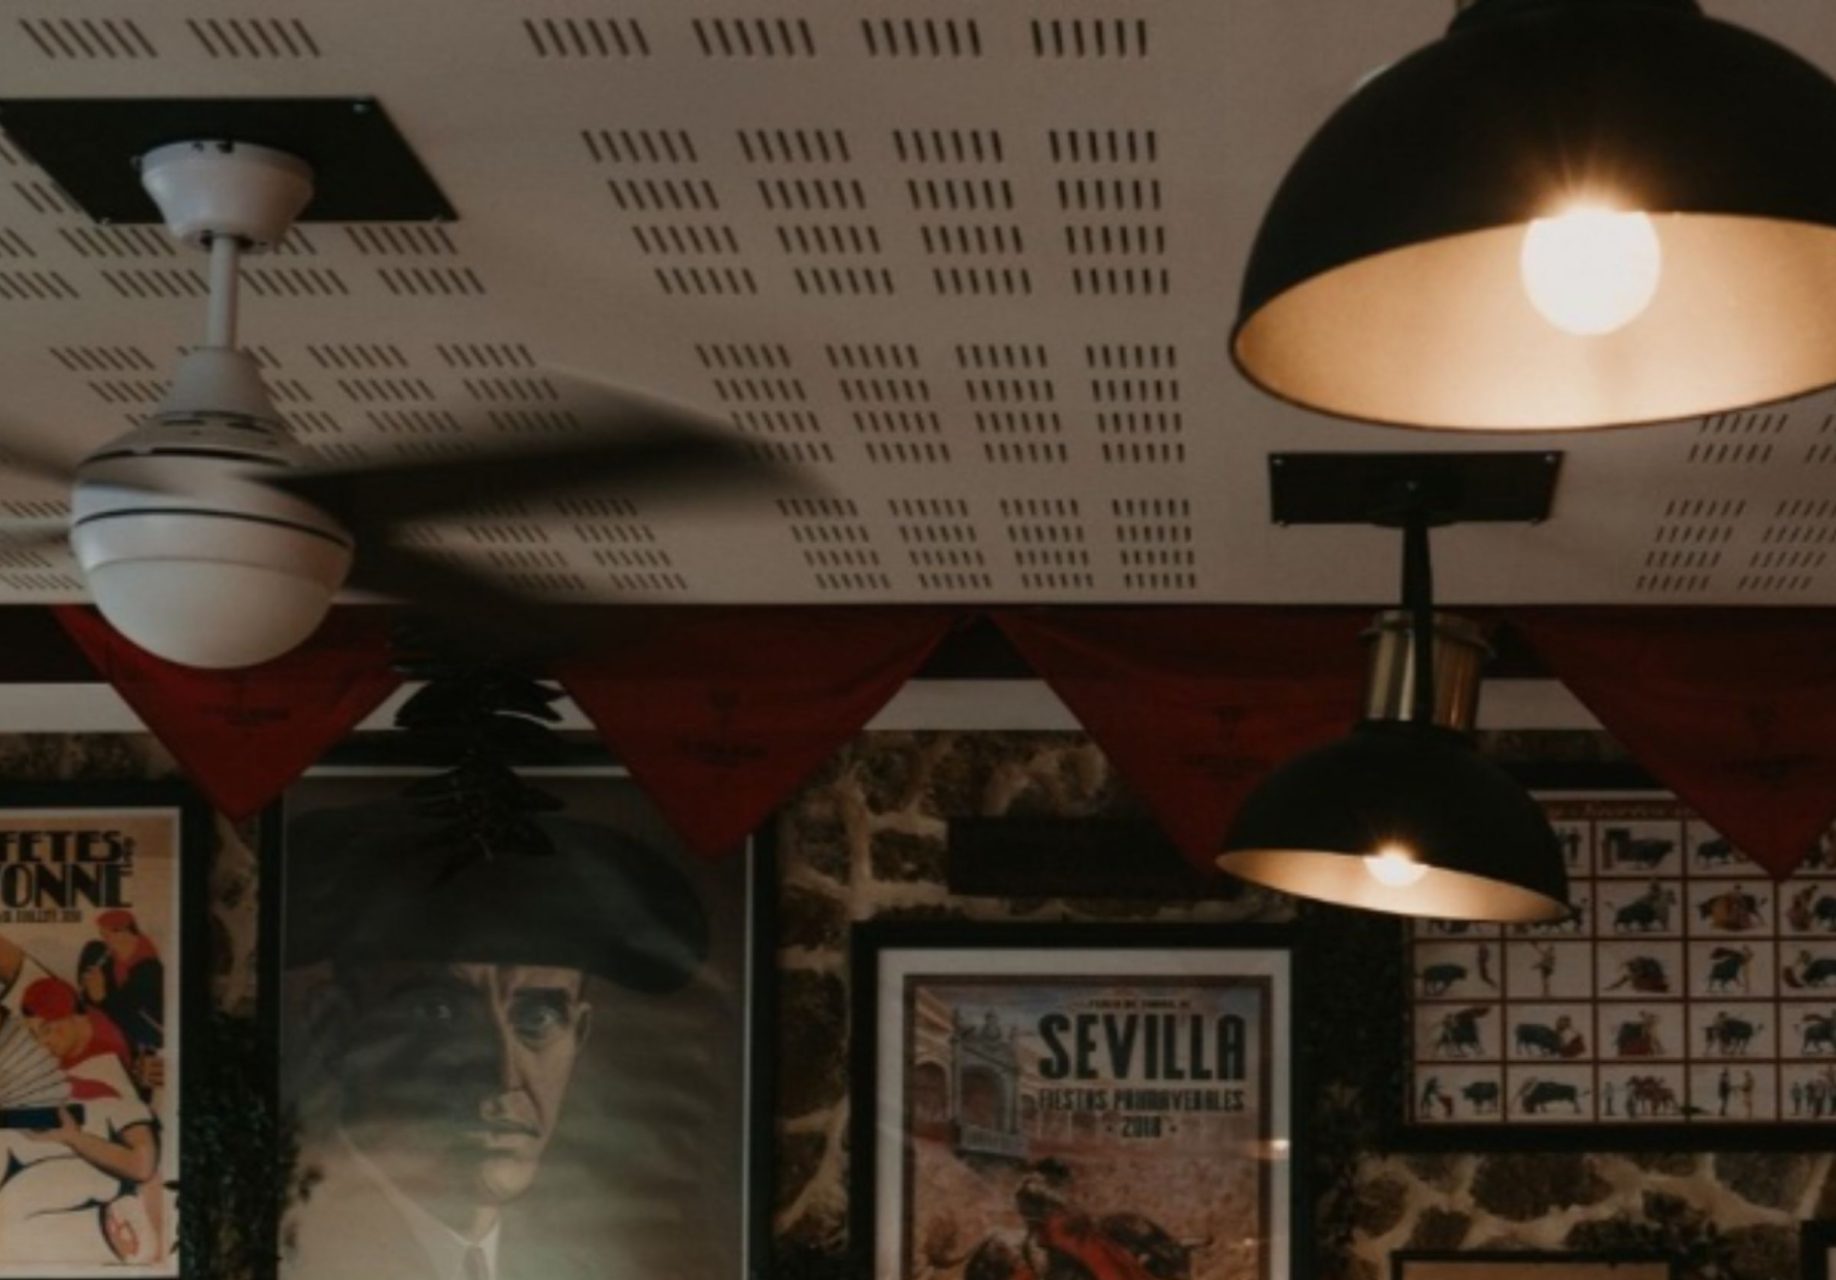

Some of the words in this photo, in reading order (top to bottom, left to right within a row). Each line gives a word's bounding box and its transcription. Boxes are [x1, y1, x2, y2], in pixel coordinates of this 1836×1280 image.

[0, 830, 121, 862] FETES
[1038, 1014, 1245, 1080] SEVILLA
[1040, 1089, 1107, 1111] FIESTAS
